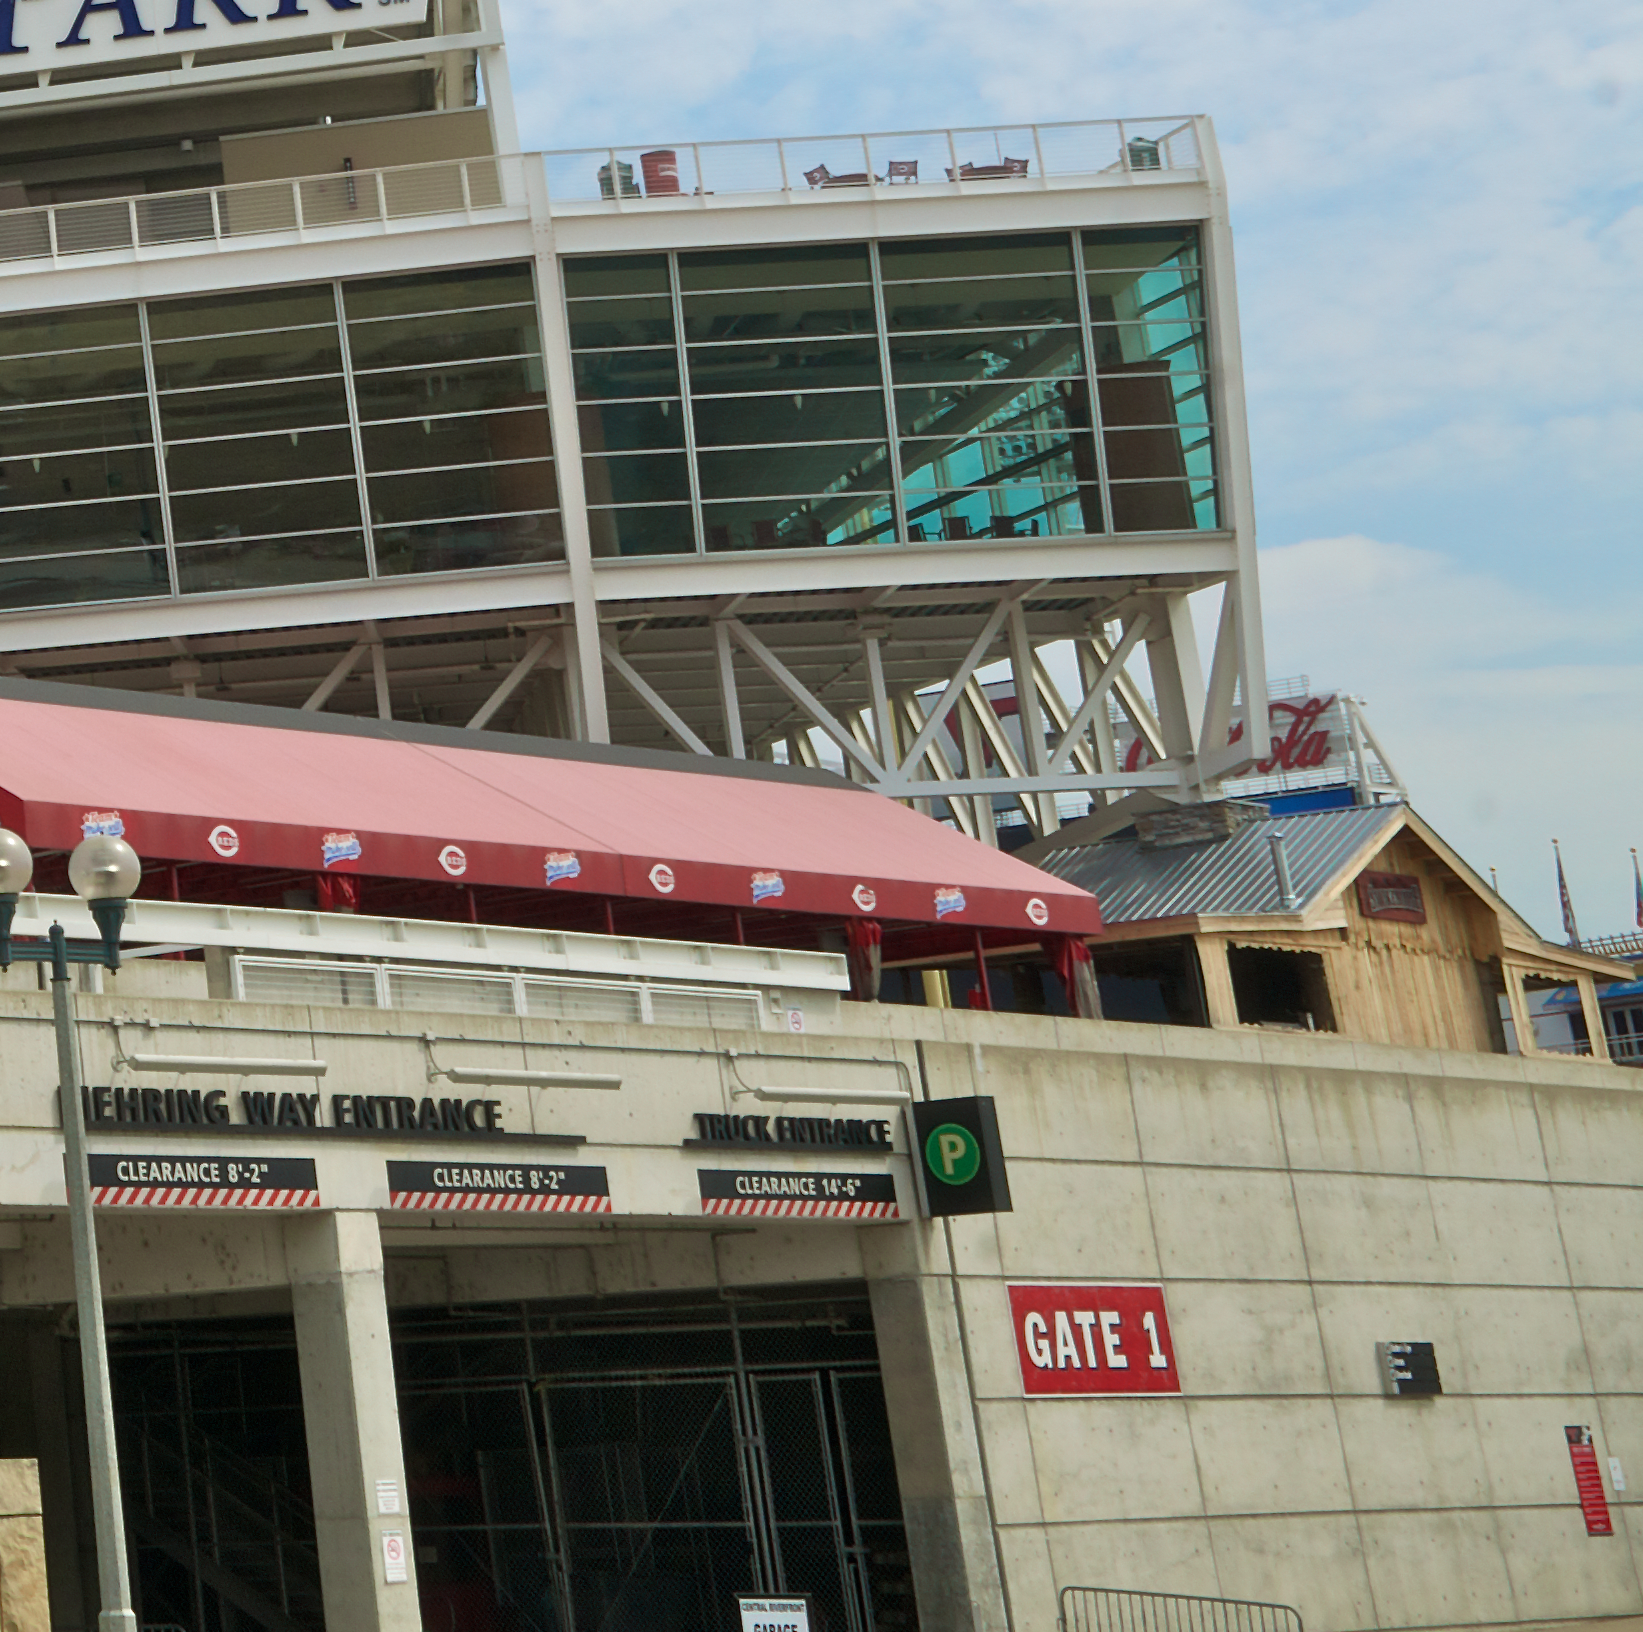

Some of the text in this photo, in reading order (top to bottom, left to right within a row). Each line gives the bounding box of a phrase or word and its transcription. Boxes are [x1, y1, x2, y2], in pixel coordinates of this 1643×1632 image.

[239, 1090, 320, 1128] WAY
[330, 1093, 505, 1134] ENTRANCE
[693, 1112, 893, 1146] TRUCK ENTRANCE
[938, 1132, 966, 1175] P
[116, 1160, 269, 1184] CLEARANCE 8'-2"
[433, 1167, 566, 1190] CLEARANCE 8'-2"
[735, 1176, 817, 1196] CLEARANCE
[1024, 1310, 1168, 1369] GATE 1
